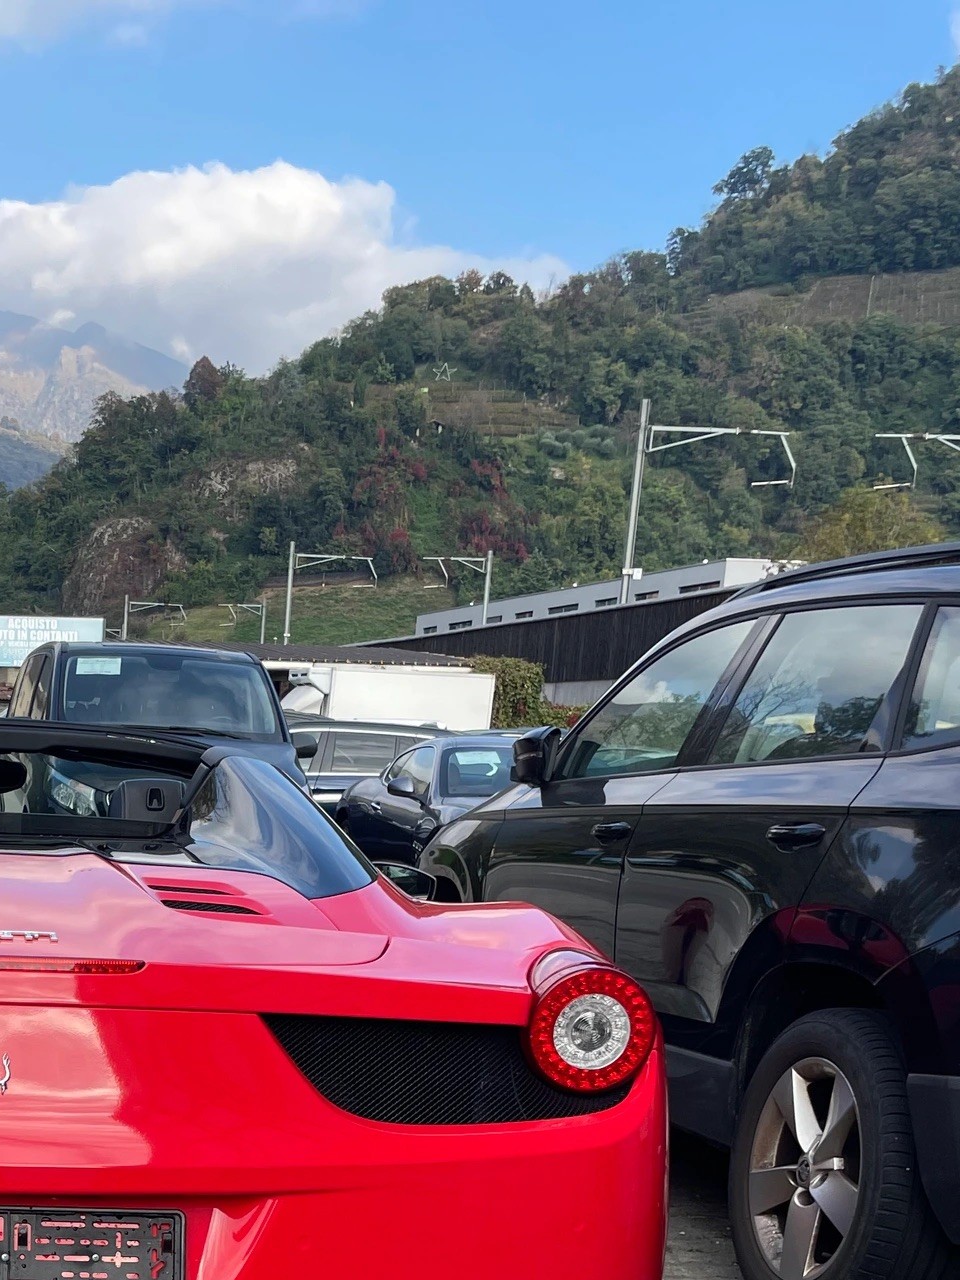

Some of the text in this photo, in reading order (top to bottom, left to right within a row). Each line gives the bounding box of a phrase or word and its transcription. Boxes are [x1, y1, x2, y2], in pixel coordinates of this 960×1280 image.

[7, 618, 58, 630] ACQUISTO
[17, 630, 27, 641] IN
[29, 631, 78, 642] CONTANTI
